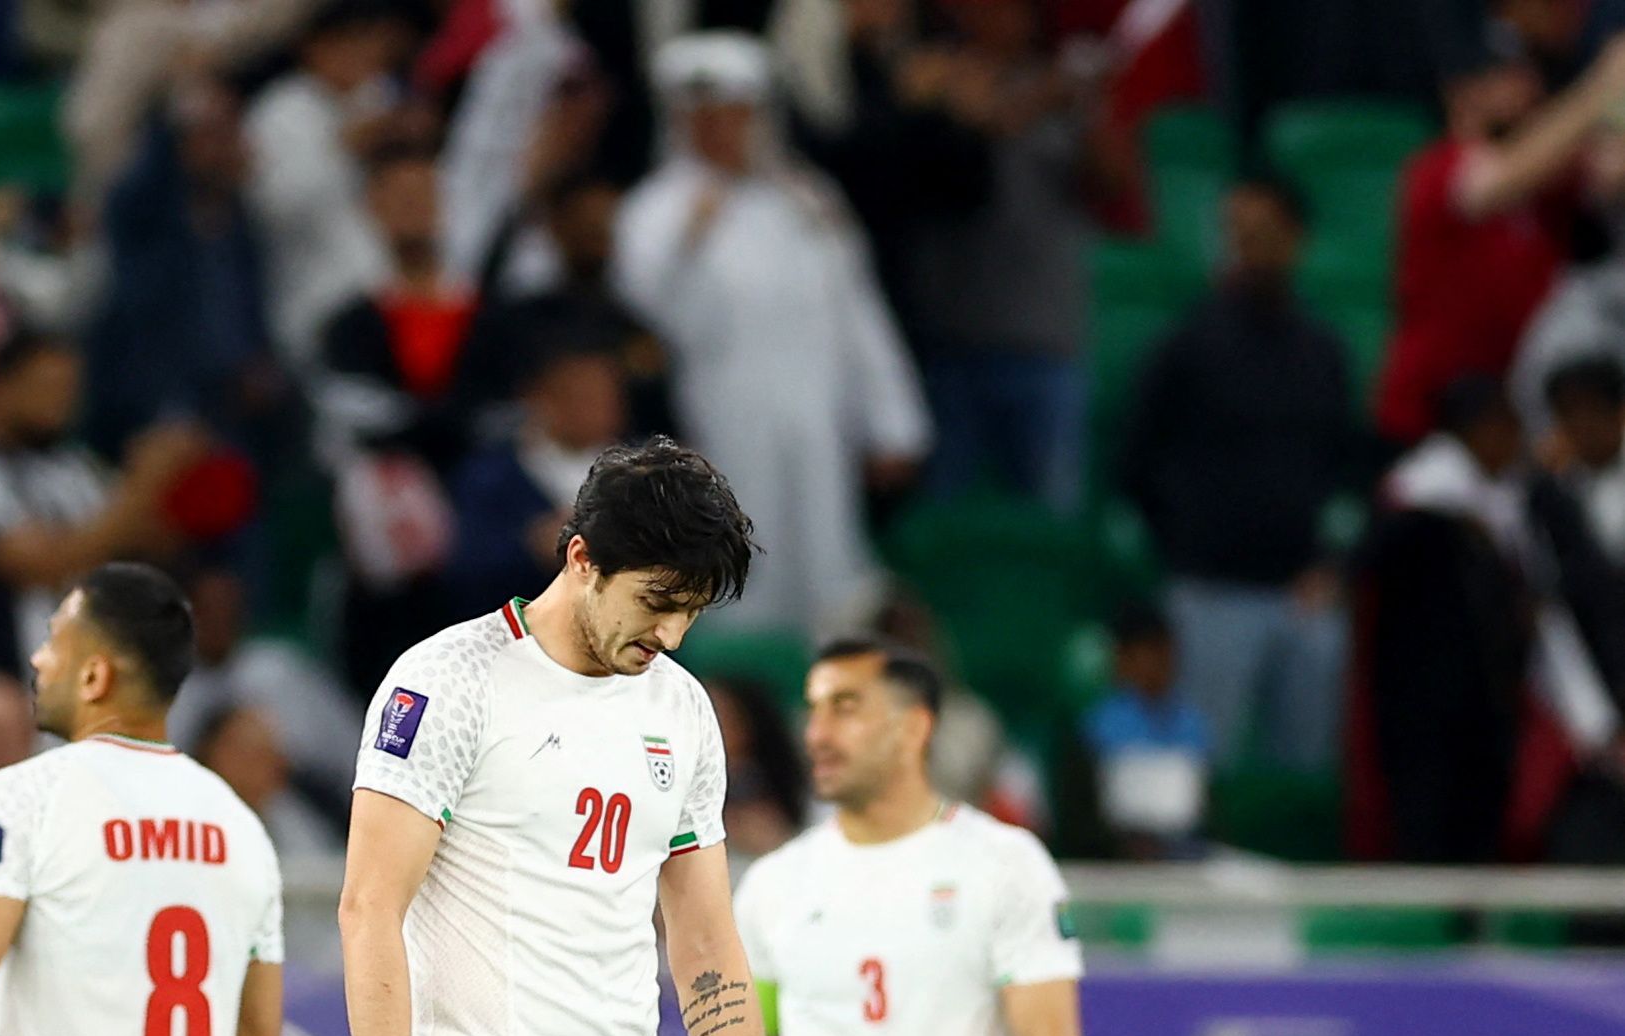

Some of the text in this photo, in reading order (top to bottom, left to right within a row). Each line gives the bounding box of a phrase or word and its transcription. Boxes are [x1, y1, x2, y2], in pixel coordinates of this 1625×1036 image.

[103, 818, 228, 865] OMID
[568, 787, 632, 874] 20
[858, 957, 889, 1023] 3
